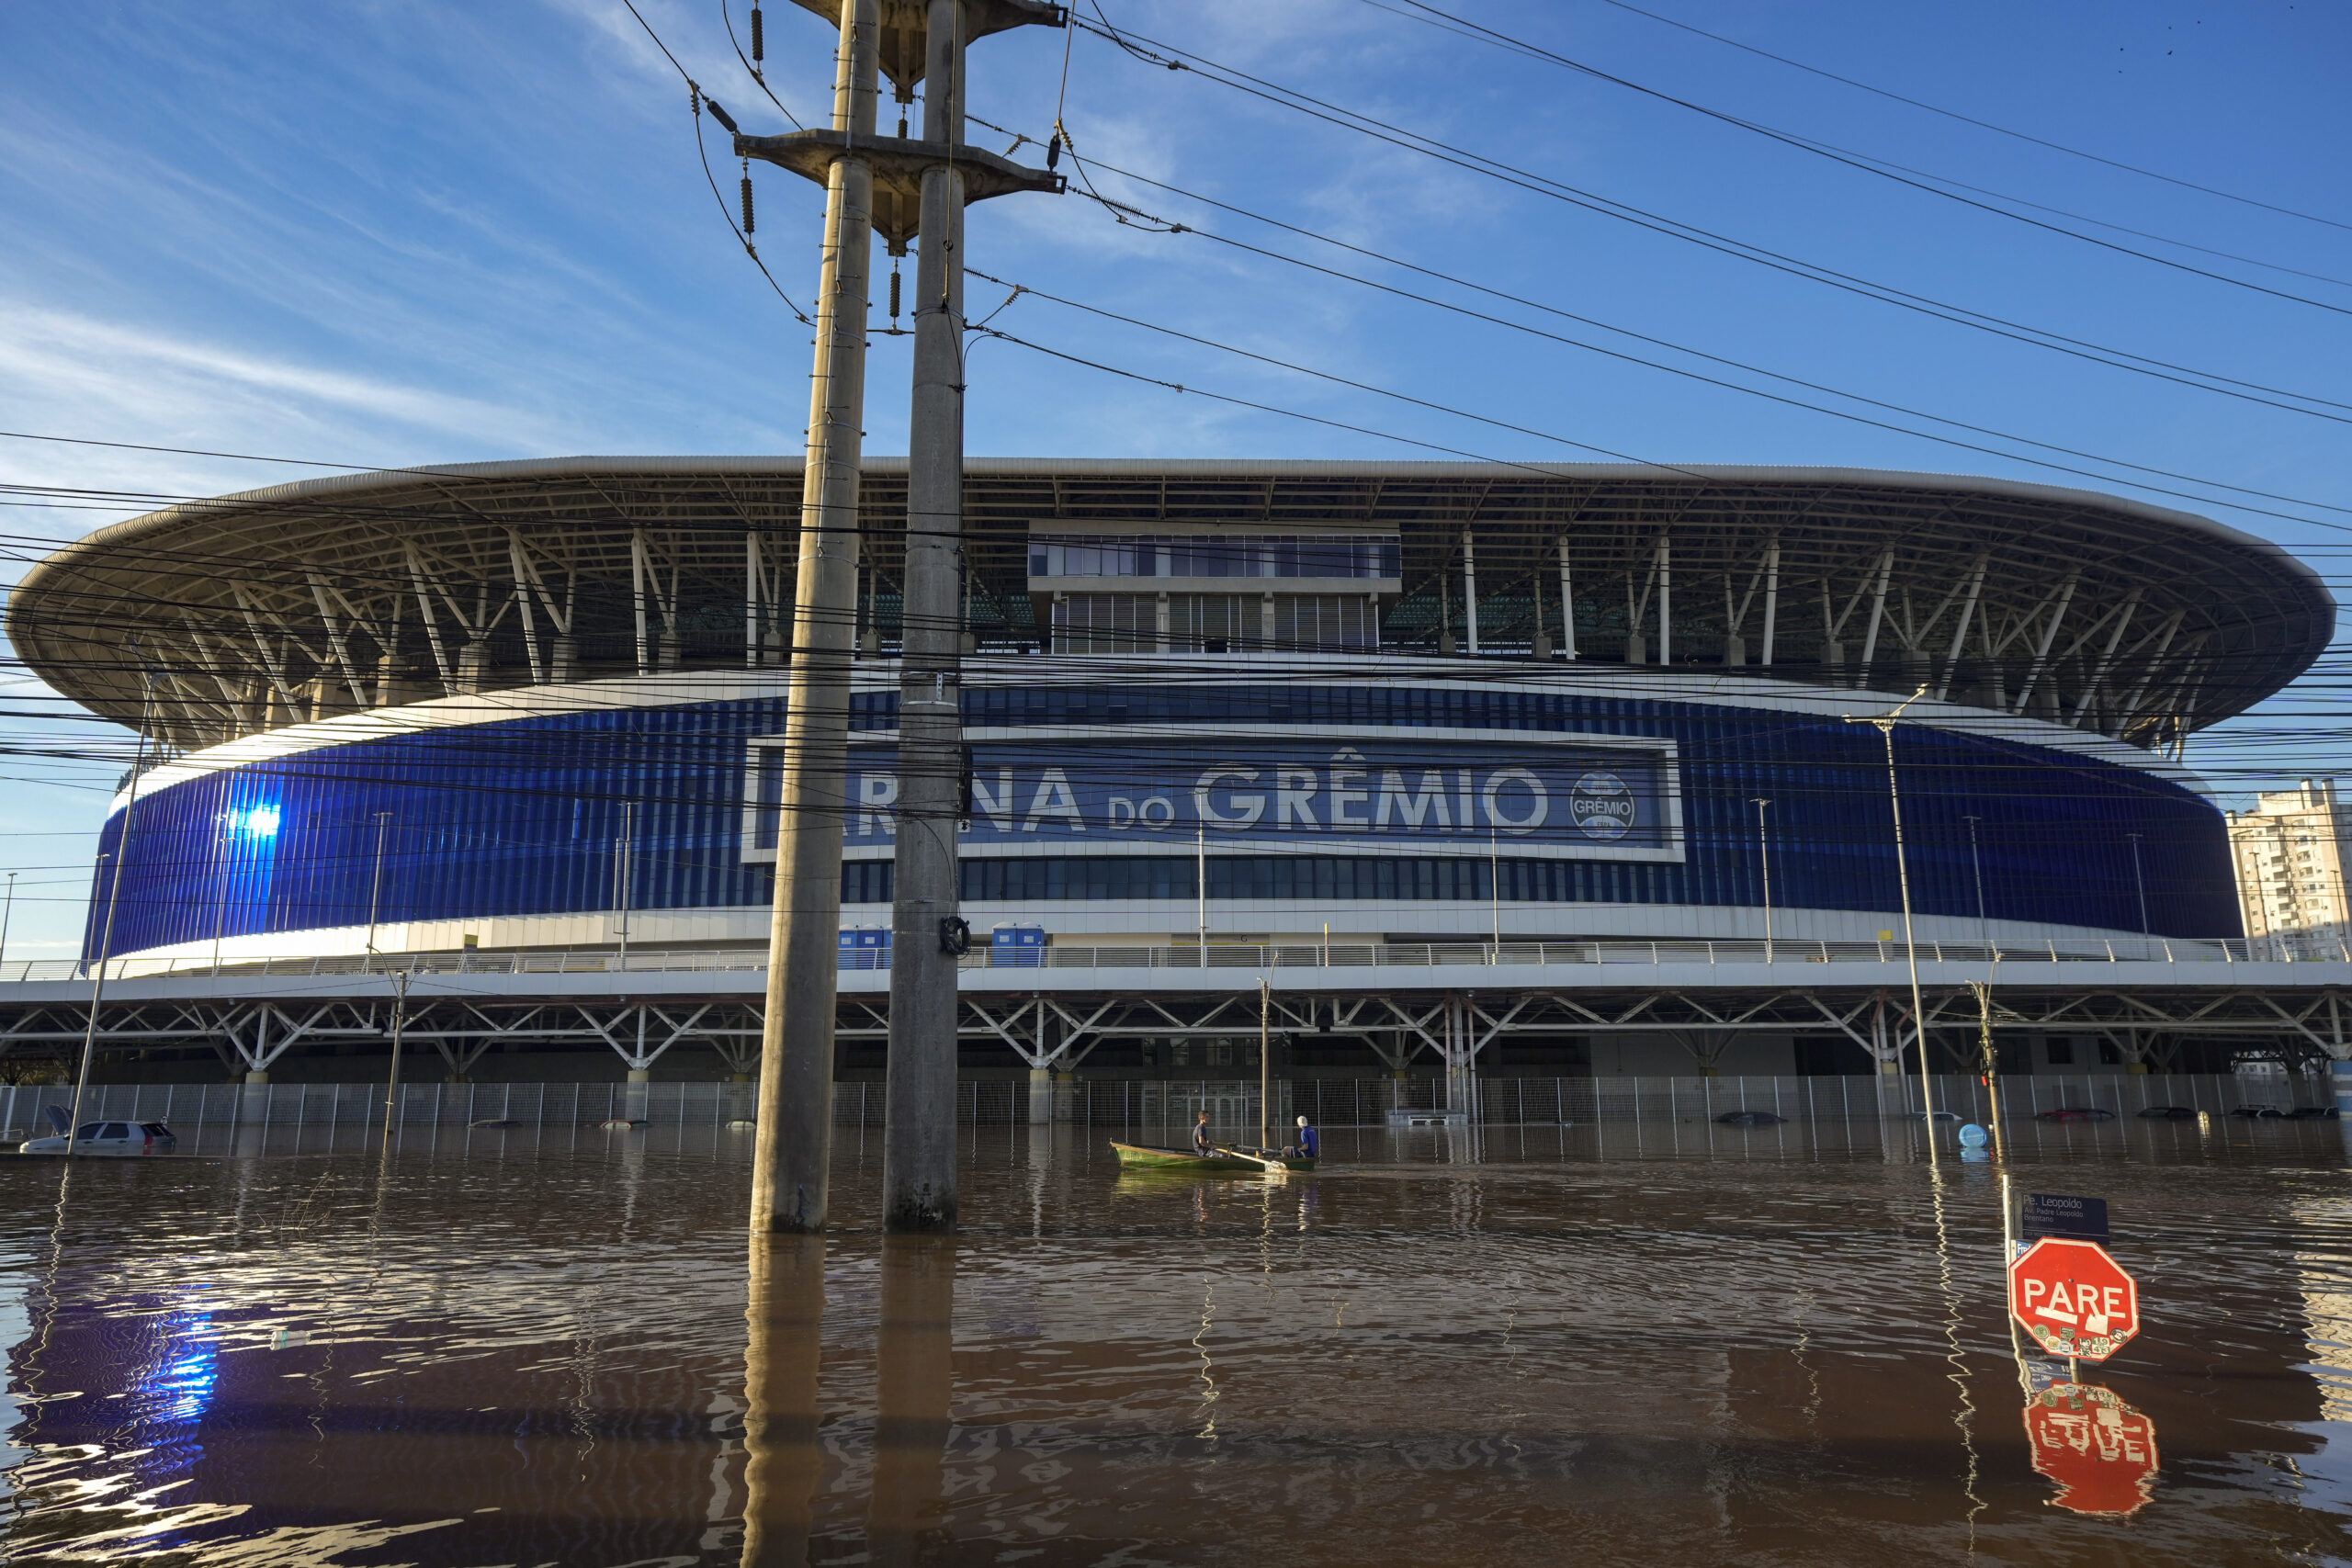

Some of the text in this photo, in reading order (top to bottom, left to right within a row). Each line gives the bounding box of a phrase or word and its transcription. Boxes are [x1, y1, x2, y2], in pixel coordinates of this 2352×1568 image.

[1108, 796, 1176, 831] DO
[1193, 747, 1548, 835] GRÊMIO
[1574, 797, 1631, 815] GRÊMIO
[2023, 1194, 2082, 1209] Pe. Leopoldo
[2024, 1214, 2054, 1223] Brentano
[2056, 1210, 2084, 1218] Leopoldo
[2024, 1278, 2126, 1318] PARE
